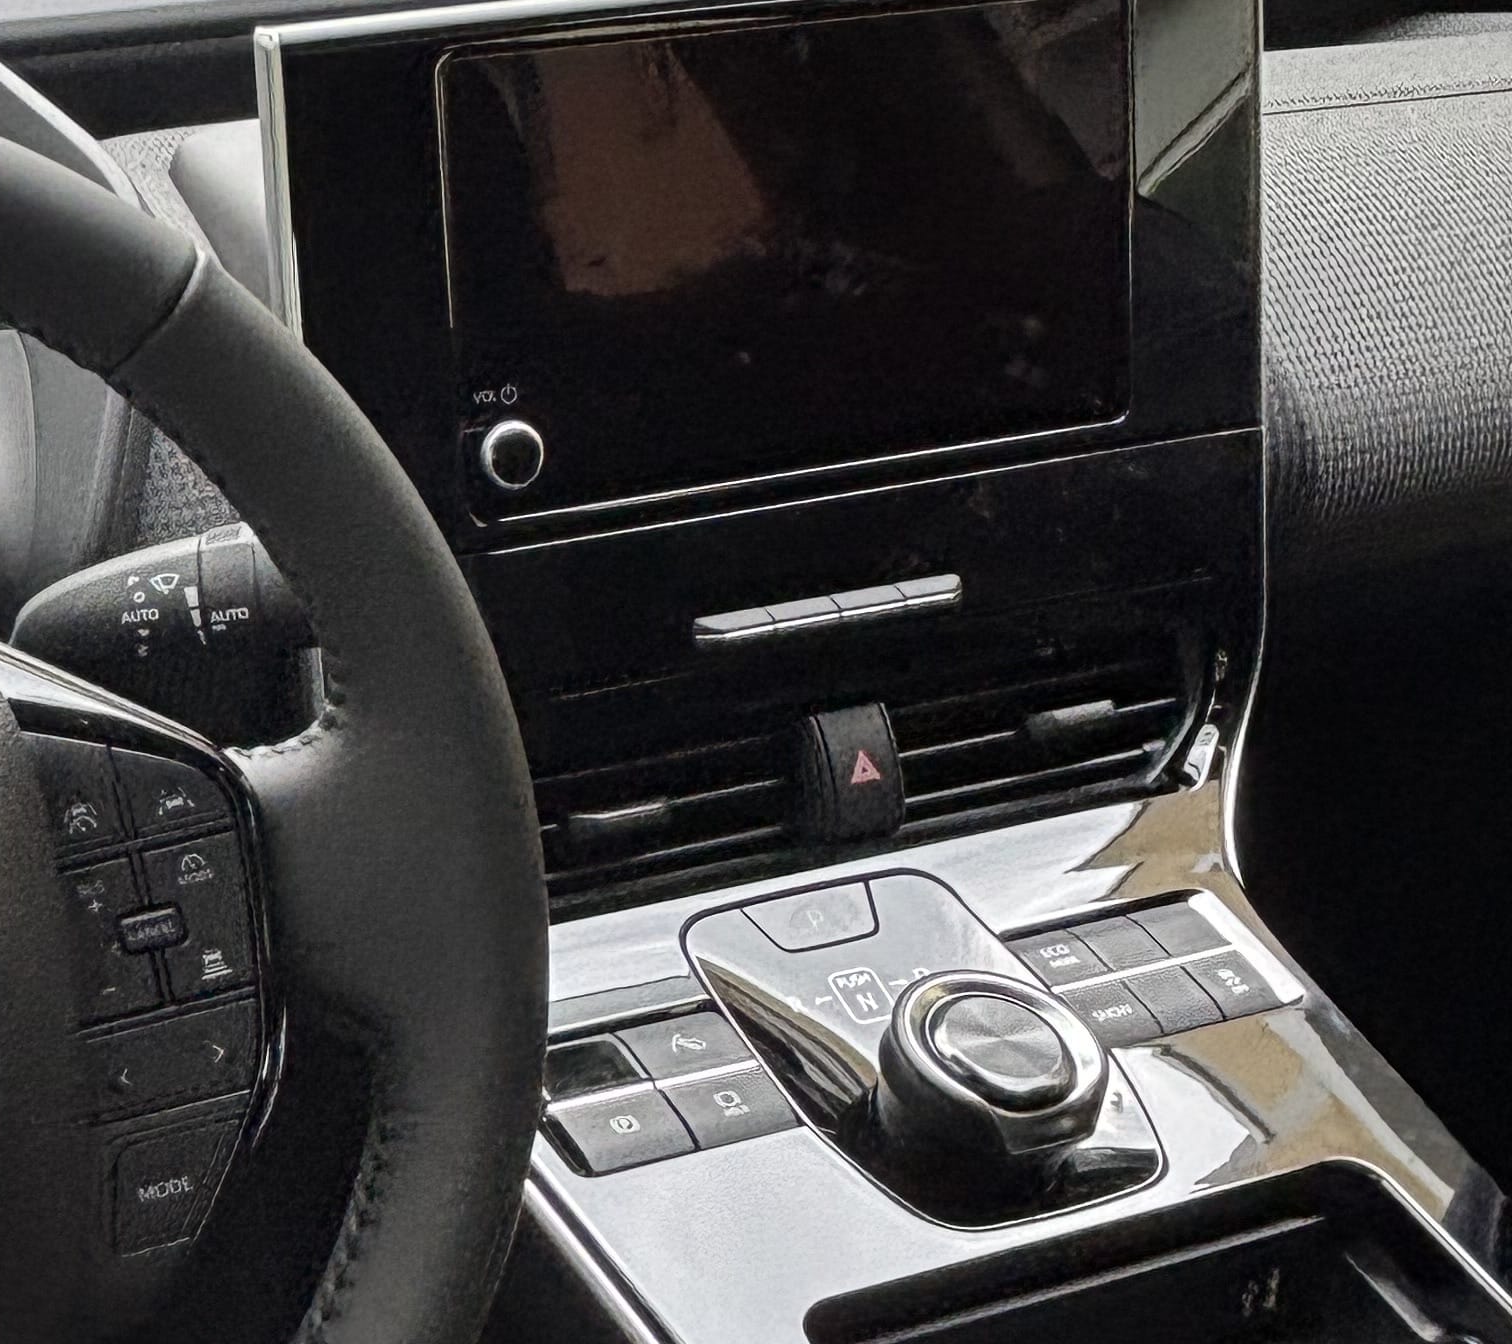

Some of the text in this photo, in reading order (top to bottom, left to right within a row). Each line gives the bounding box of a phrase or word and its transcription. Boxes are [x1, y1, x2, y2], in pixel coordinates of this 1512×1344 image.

[121, 608, 159, 625] AUTO
[210, 607, 249, 623] AUTO
[856, 992, 879, 1012] N
[138, 1175, 194, 1203] MODE
